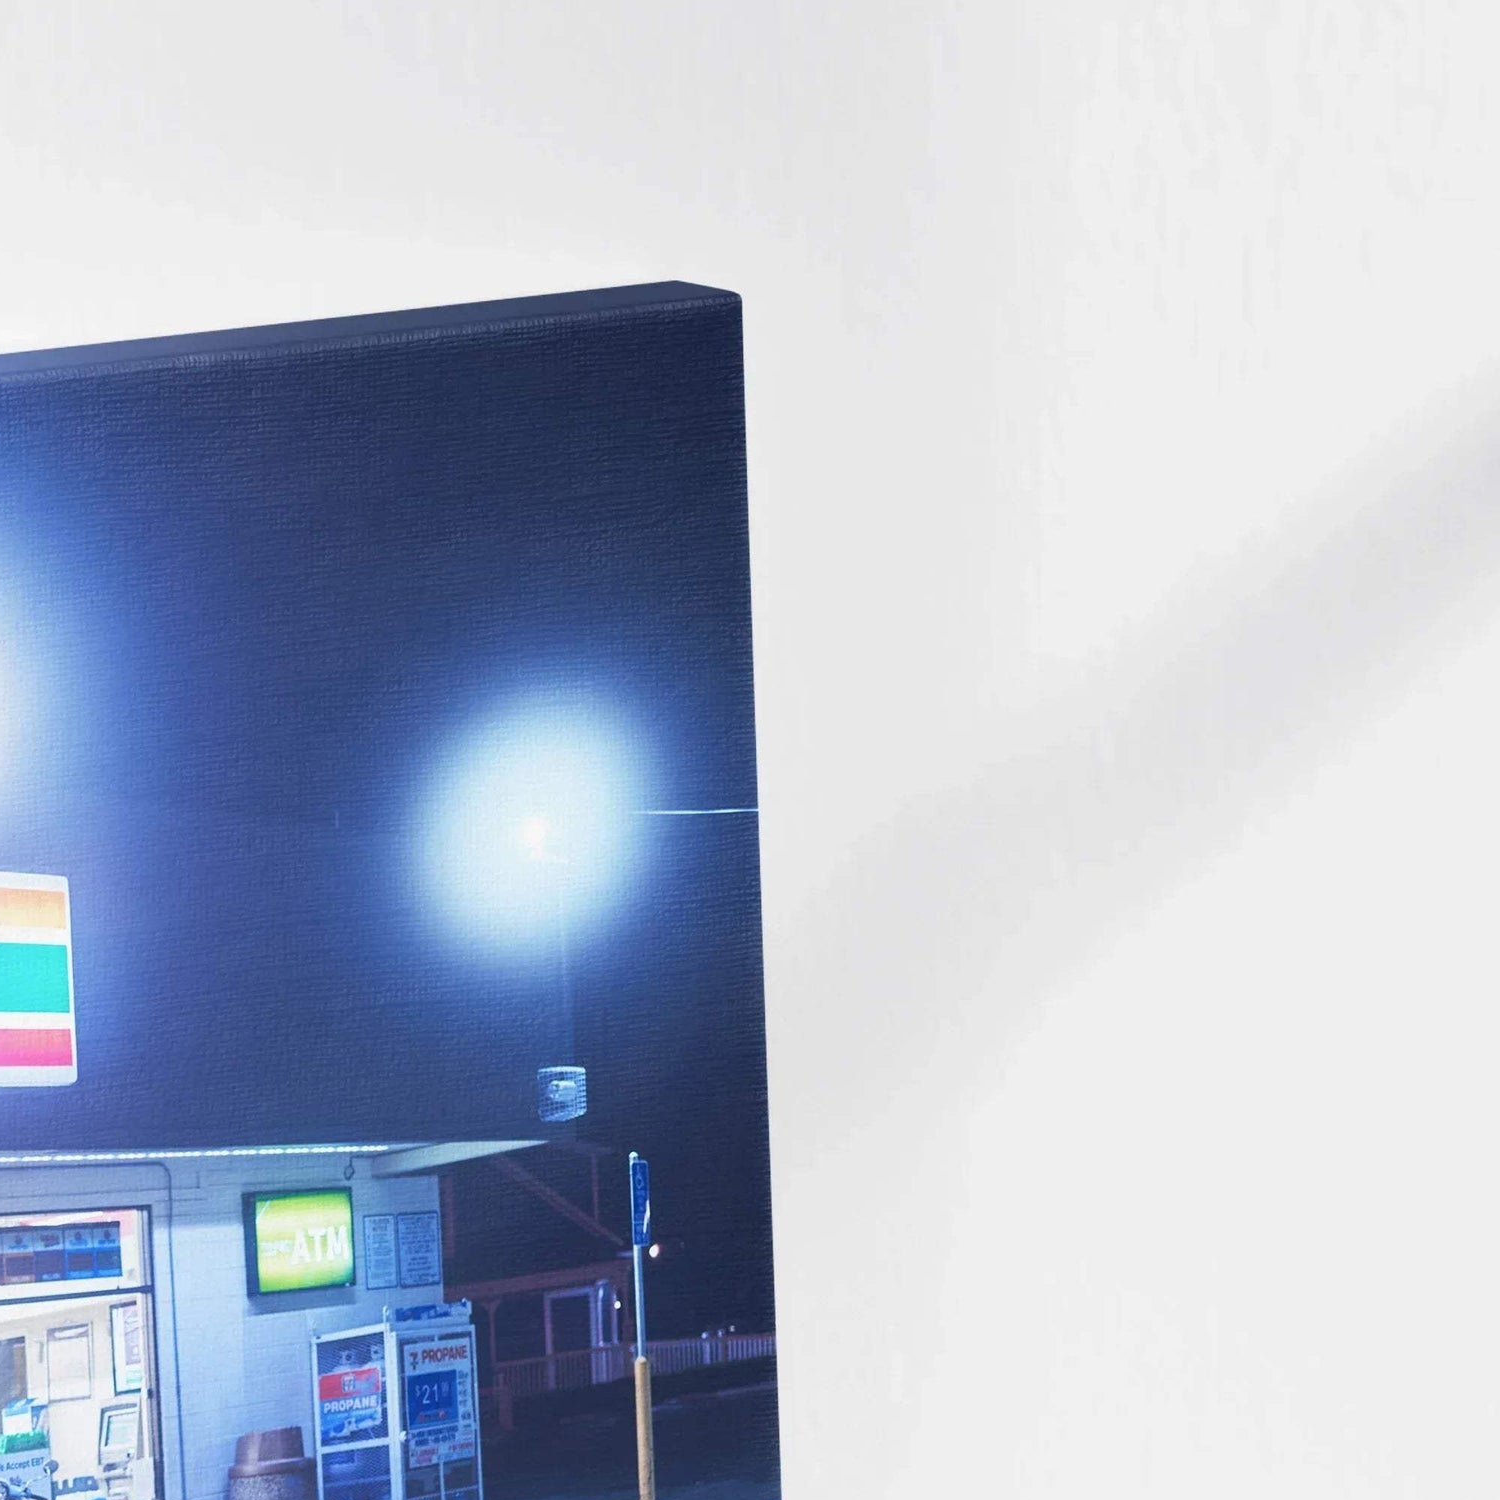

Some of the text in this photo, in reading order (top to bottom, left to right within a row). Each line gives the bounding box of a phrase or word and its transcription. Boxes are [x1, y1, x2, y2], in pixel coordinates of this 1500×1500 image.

[288, 1224, 349, 1266] ATM
[421, 1345, 468, 1364] PROPANE
[323, 1395, 378, 1414] PROPANE
[6, 1460, 30, 1470] Accept
